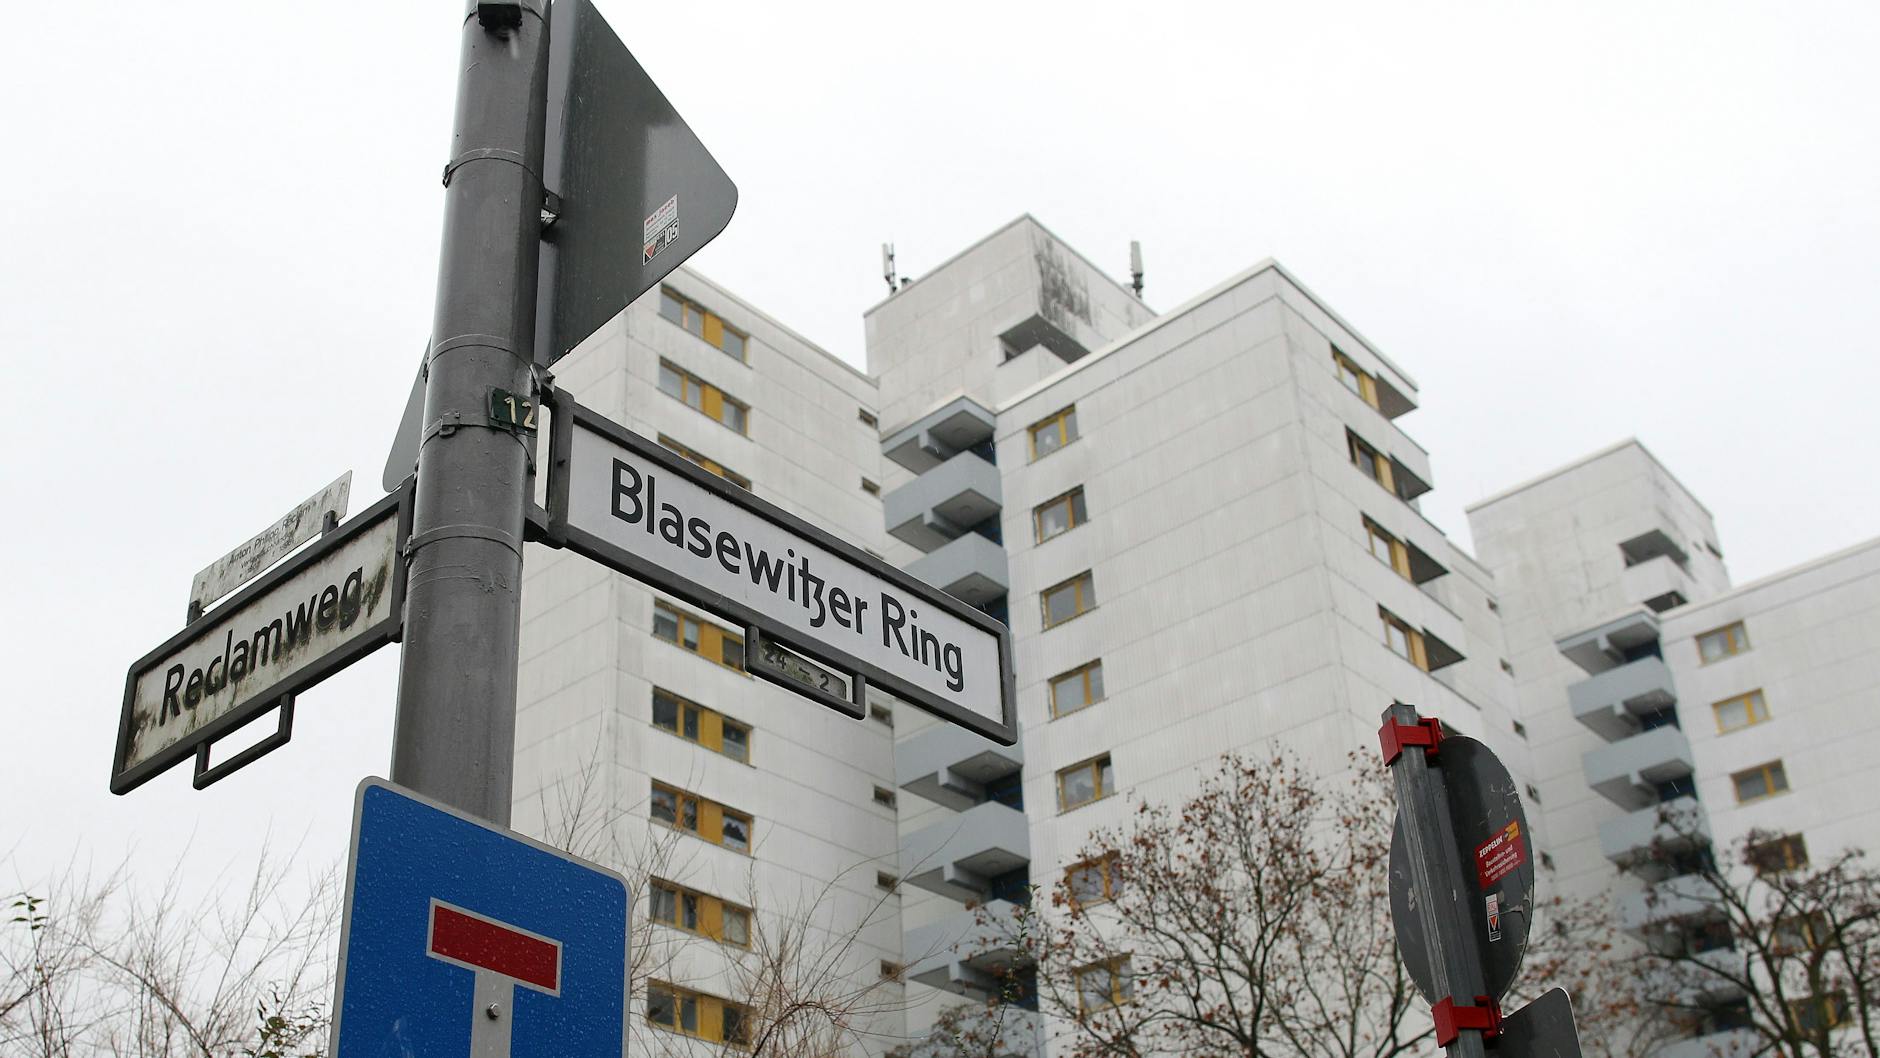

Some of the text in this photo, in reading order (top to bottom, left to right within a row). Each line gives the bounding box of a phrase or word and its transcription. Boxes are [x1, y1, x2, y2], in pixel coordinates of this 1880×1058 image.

[667, 223, 678, 243] 05
[504, 396, 536, 429] 12
[610, 457, 964, 692] Blasewitzer Ring
[159, 566, 363, 726] Reclamweg
[764, 648, 787, 670] 24
[819, 673, 830, 692] 2
[1479, 835, 1503, 858] ZEPPELIN
